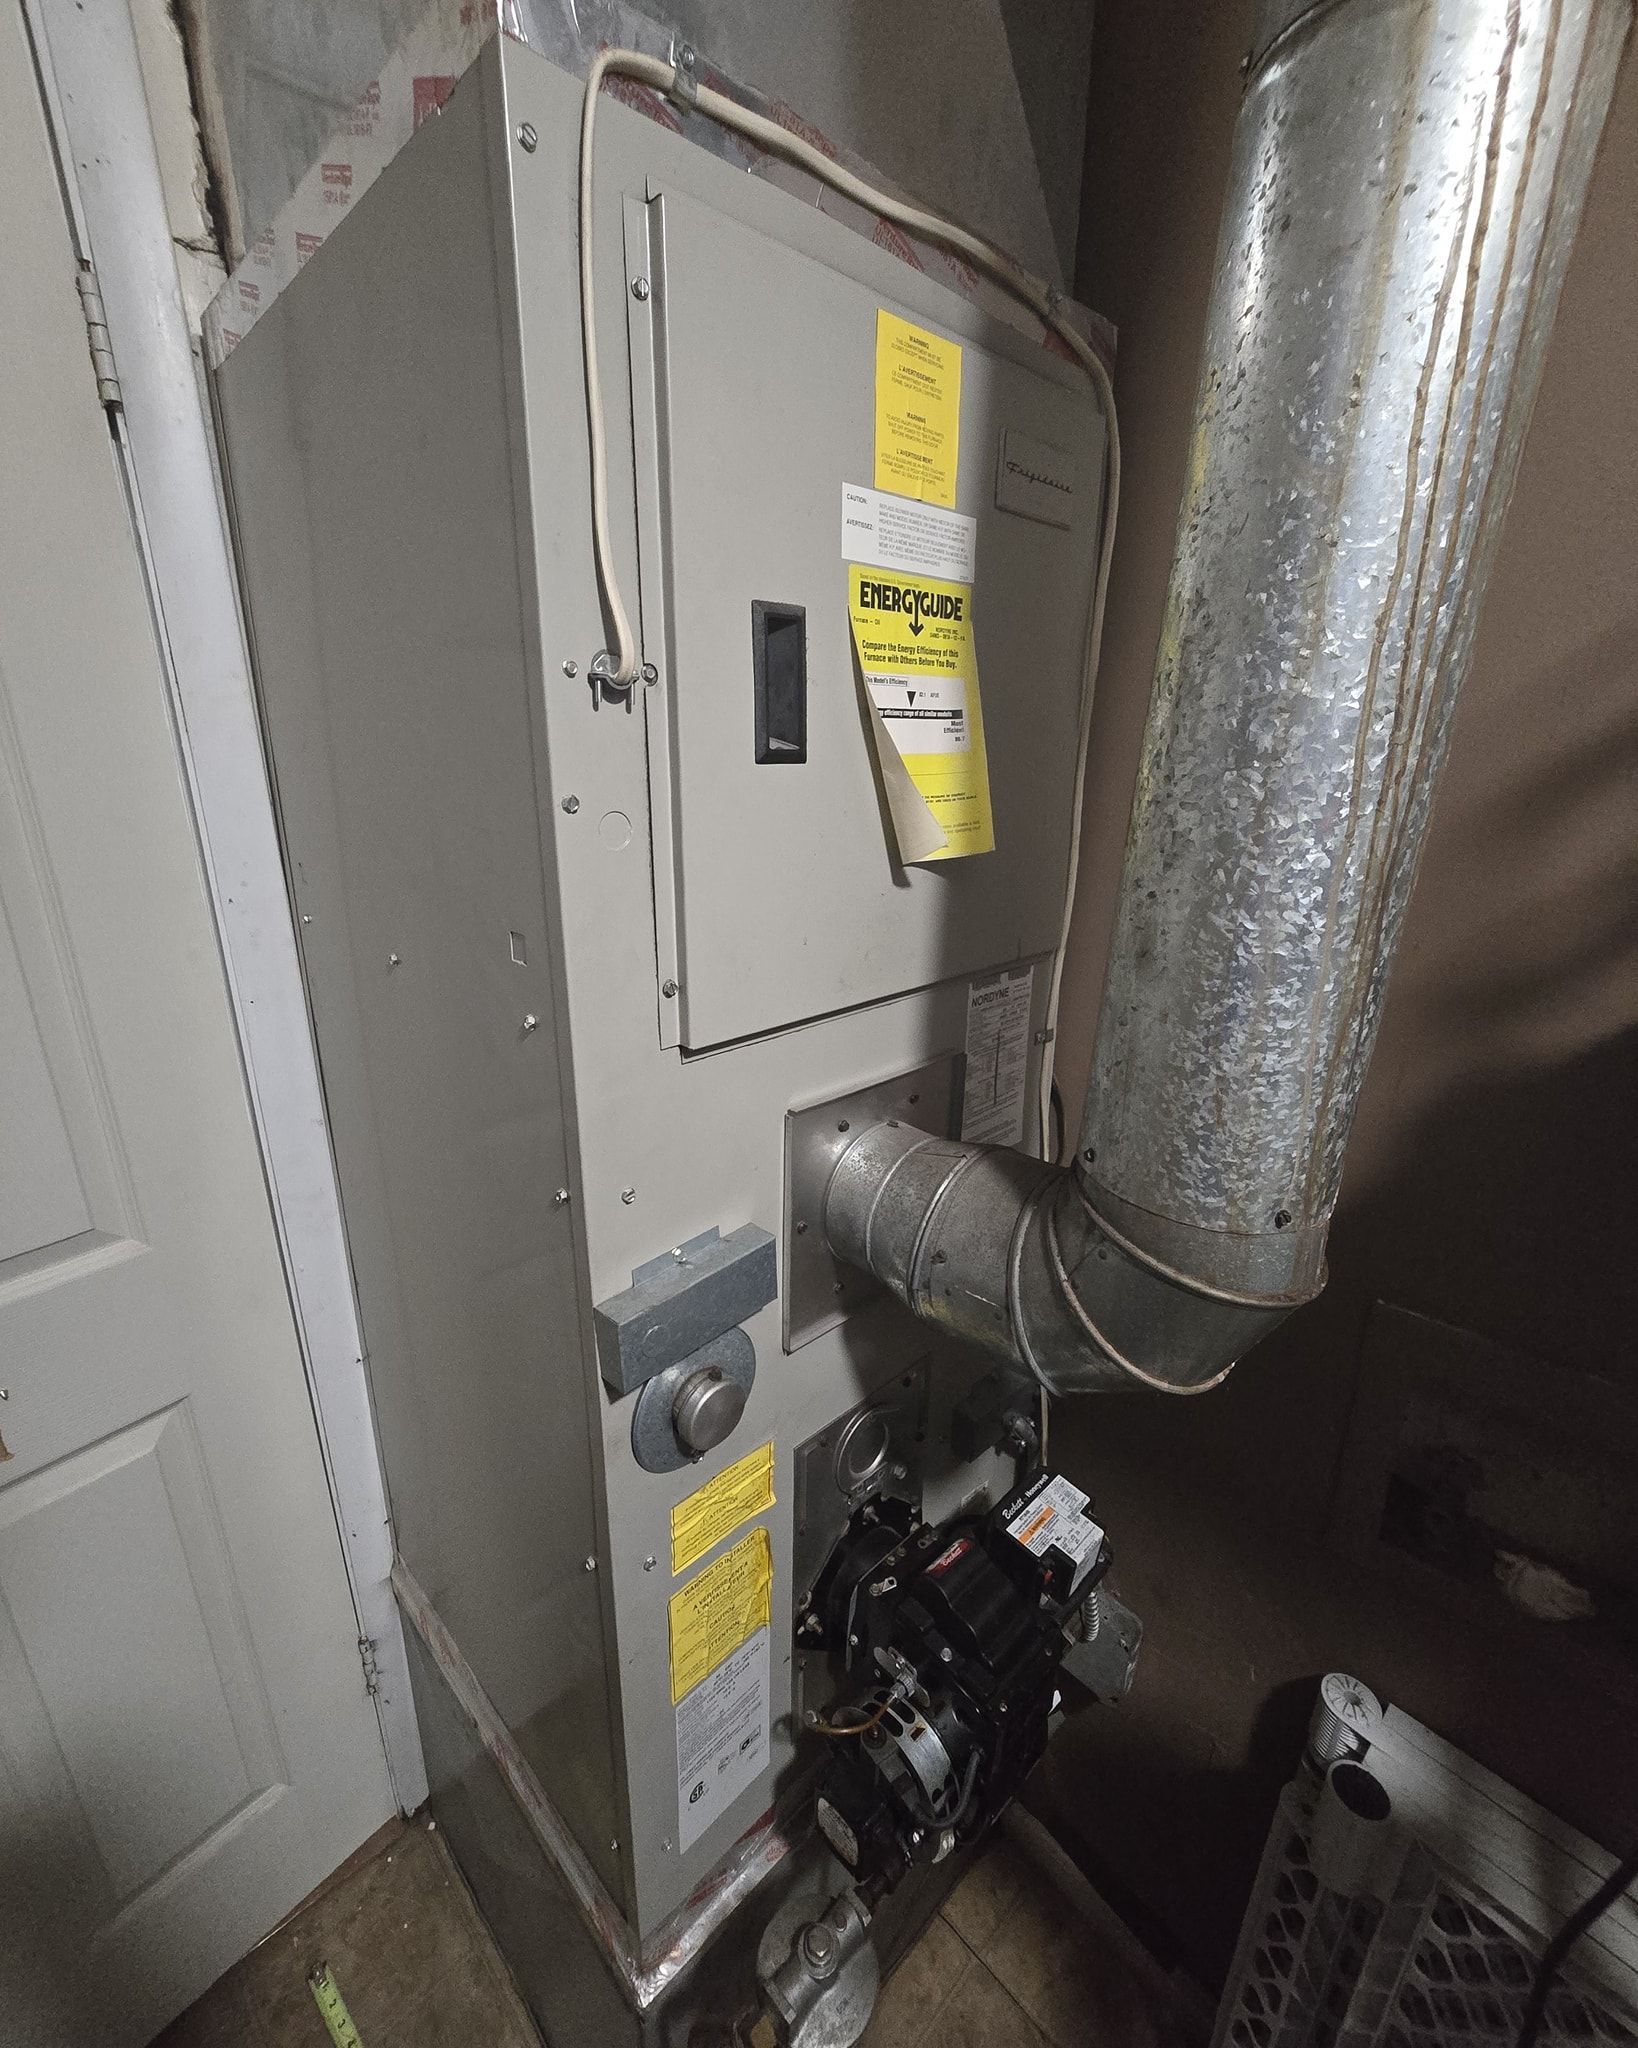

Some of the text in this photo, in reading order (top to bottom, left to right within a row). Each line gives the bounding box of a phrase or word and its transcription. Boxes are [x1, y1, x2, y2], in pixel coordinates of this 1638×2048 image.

[860, 580, 963, 622] ENERGYGUIDE
[861, 639, 959, 657] Compare the Energy Efficiency of this
[863, 651, 957, 669] Furnace with Others Before You Buy.
[971, 986, 1010, 1008] NORDYNE
[1002, 1497, 1025, 1520] Beckett
[1024, 1473, 1049, 1498] Honeywell
[684, 1569, 714, 1597] WARNING
[715, 1562, 724, 1572] TO
